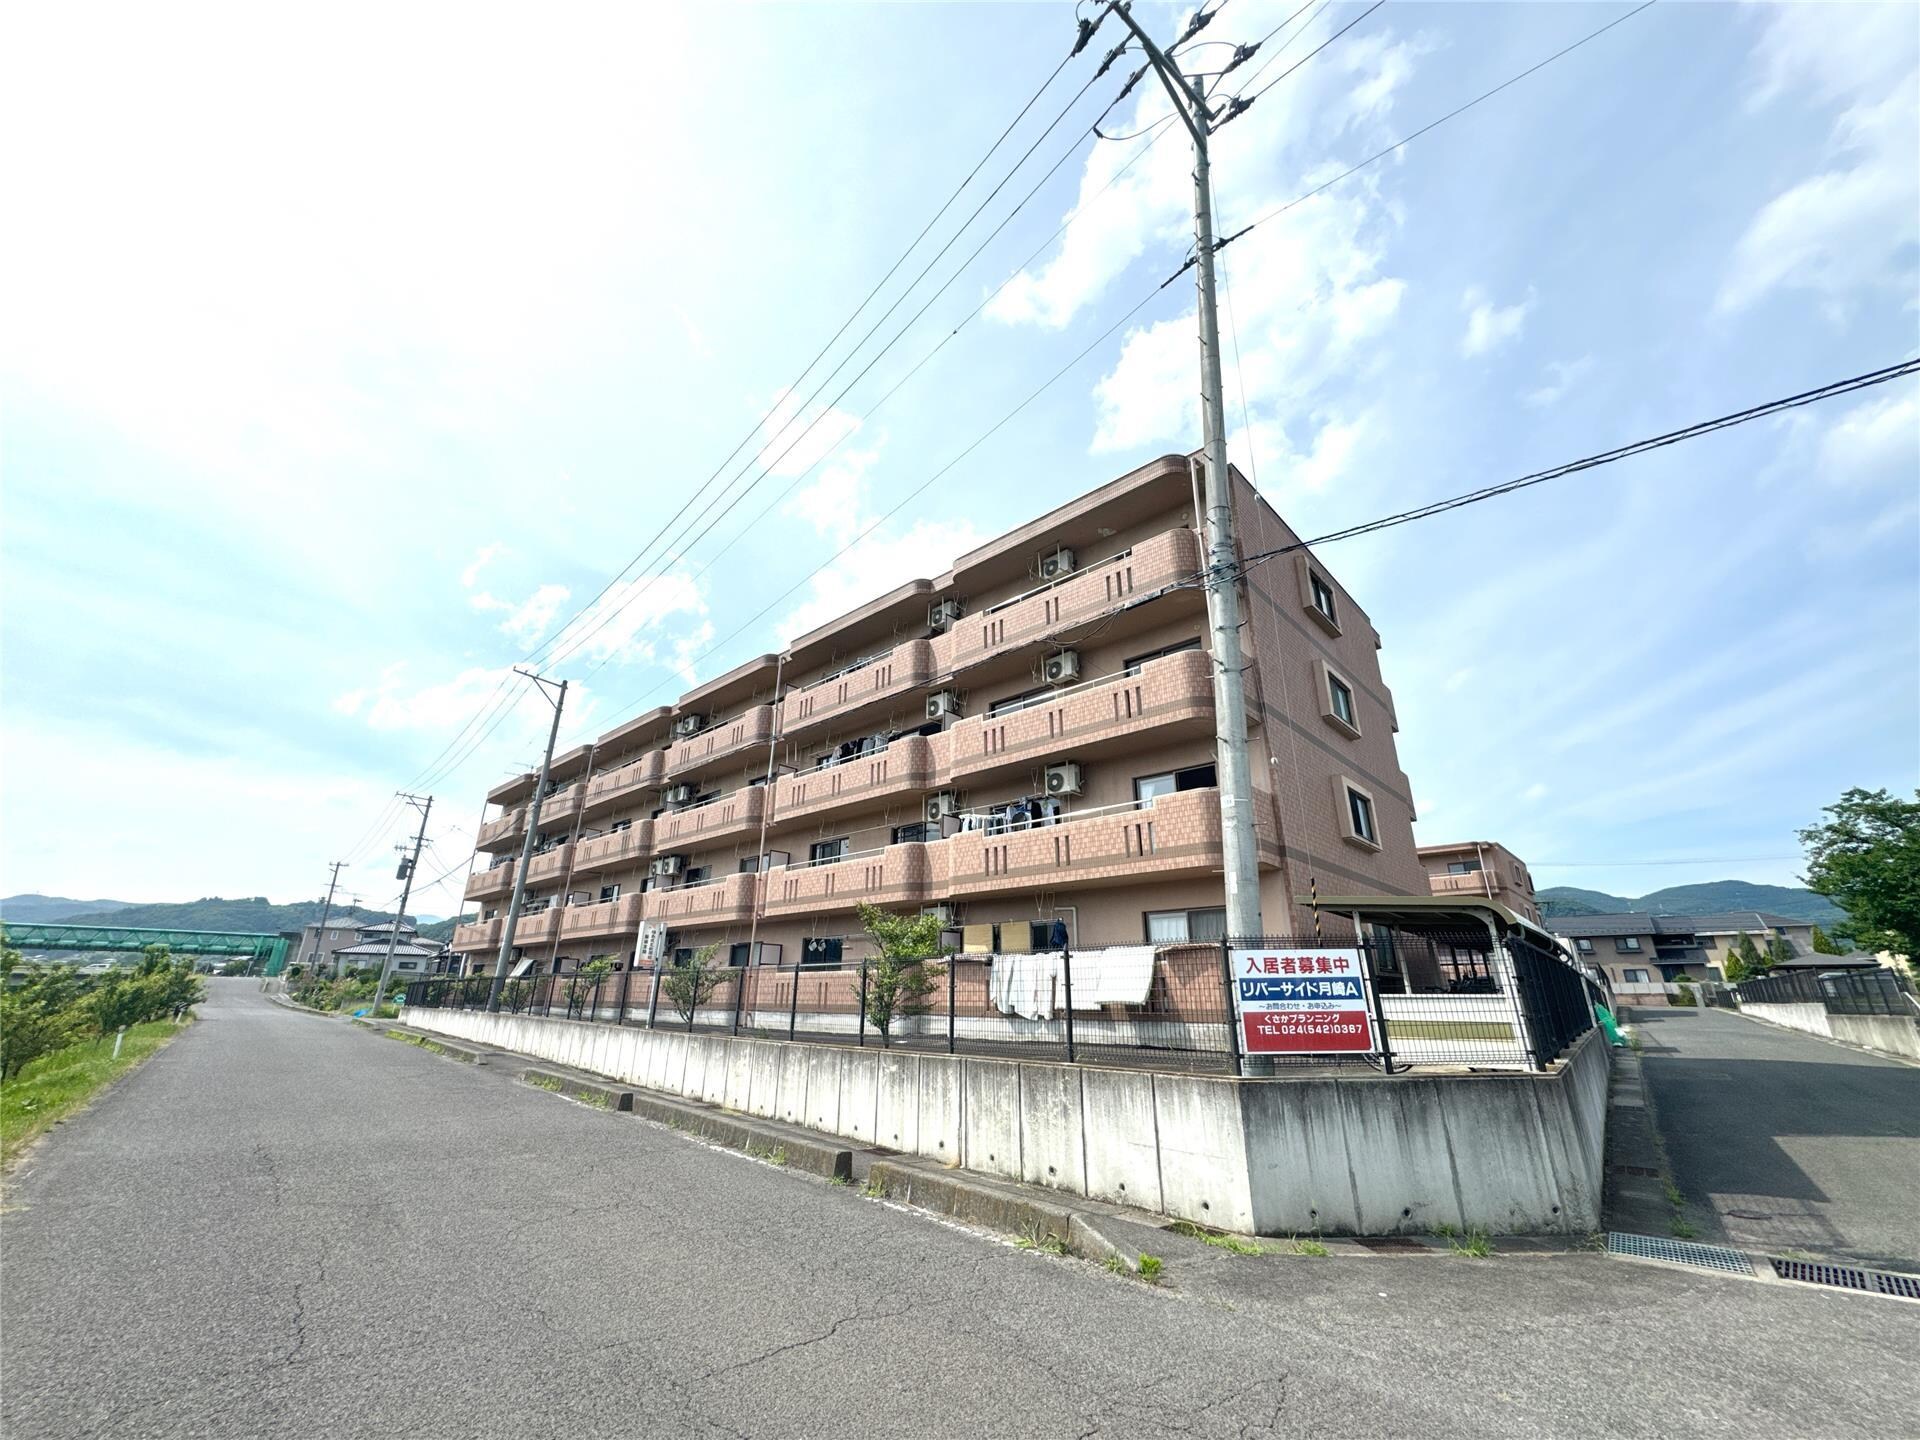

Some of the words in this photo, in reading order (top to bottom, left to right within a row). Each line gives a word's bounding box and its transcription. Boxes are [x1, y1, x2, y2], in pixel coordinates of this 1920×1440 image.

[1246, 956, 1350, 974] 入居者募集中
[1264, 1014, 1340, 1023] くさかプランニング
